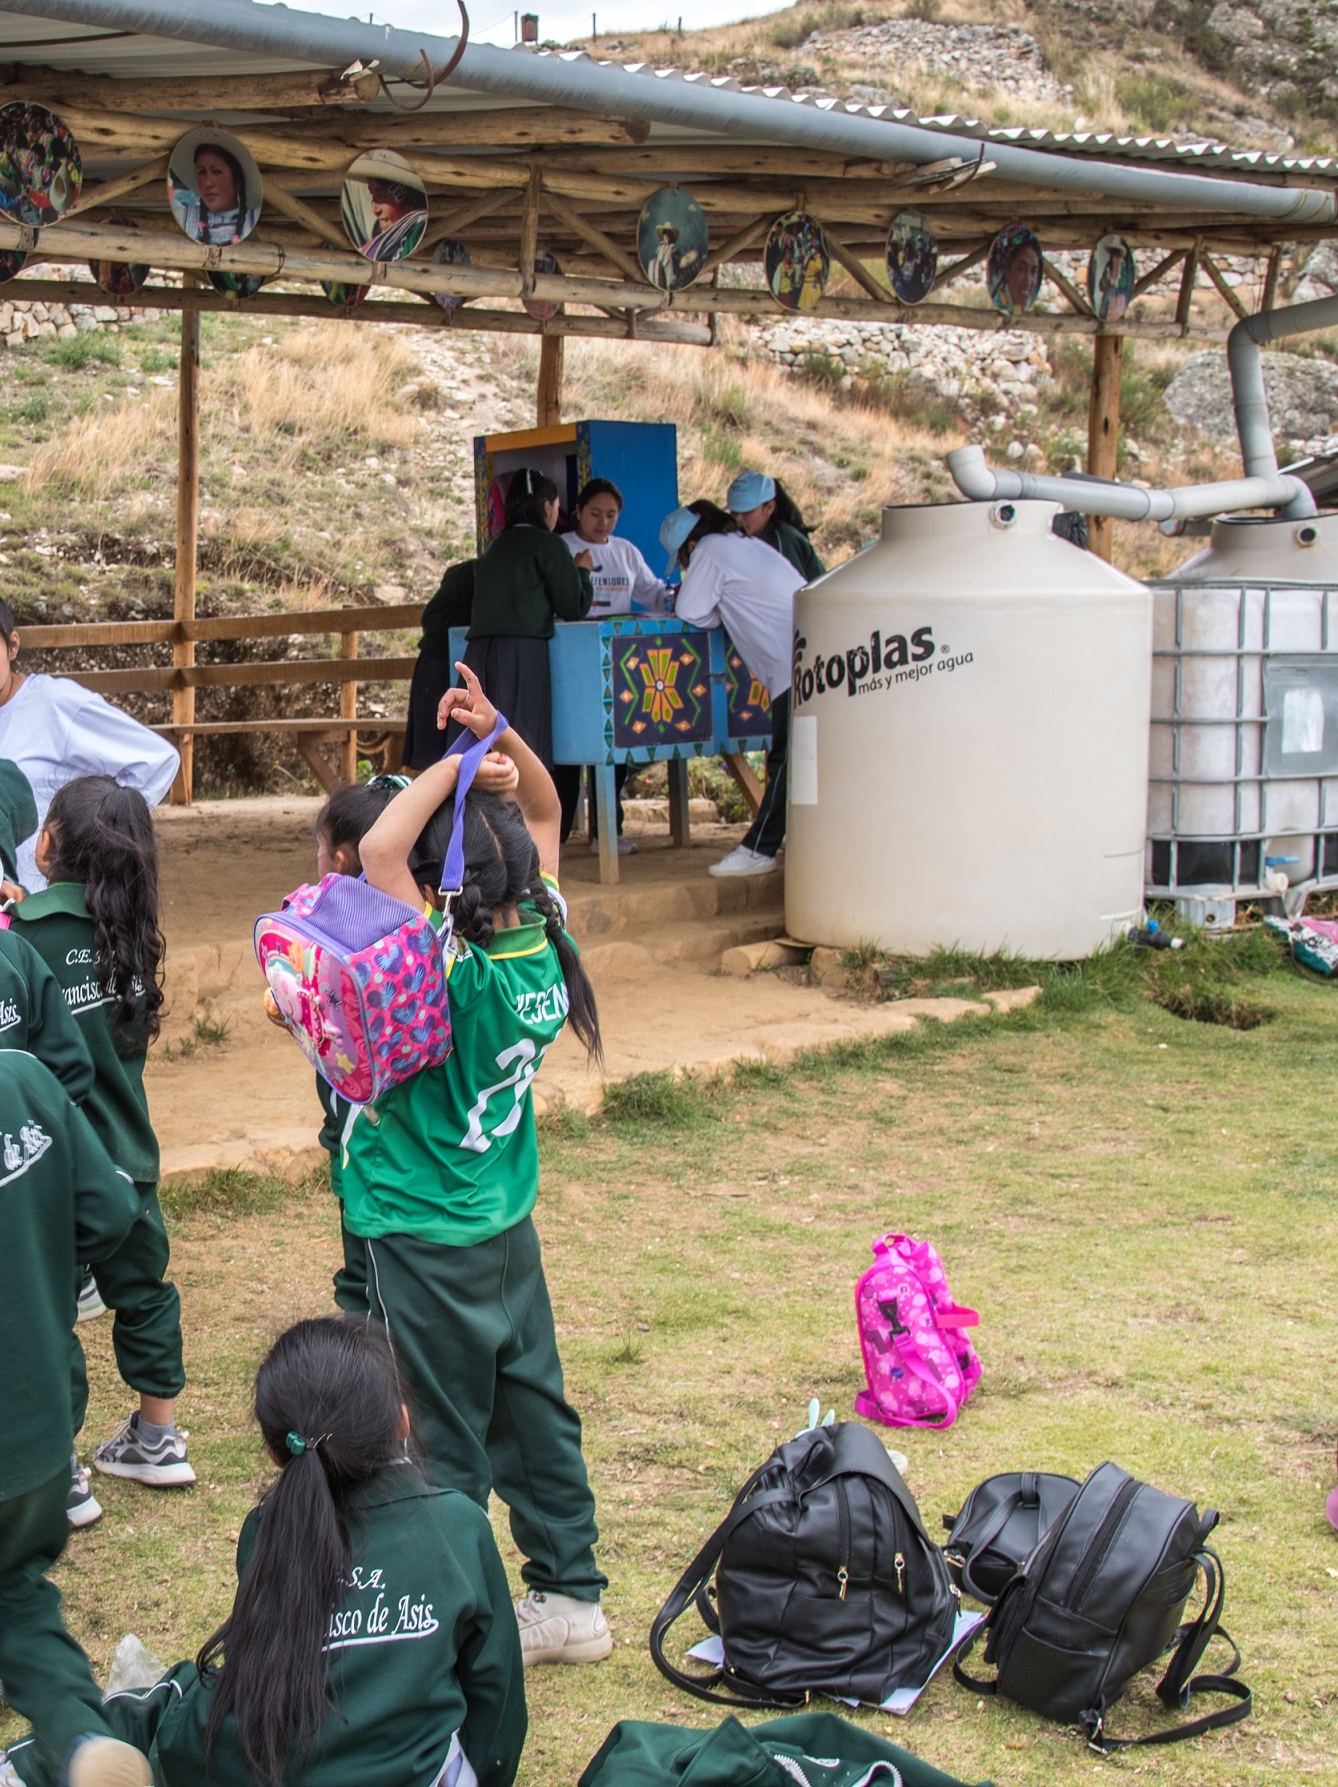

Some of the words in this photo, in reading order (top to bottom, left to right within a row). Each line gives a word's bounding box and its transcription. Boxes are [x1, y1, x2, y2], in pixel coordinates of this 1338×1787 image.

[793, 626, 935, 711] Rotoplas
[858, 678, 883, 695] más
[886, 675, 892, 691] y
[895, 664, 935, 683] mejor
[937, 652, 974, 673] agua
[366, 1592, 389, 1634] de
[391, 1593, 436, 1635] Asis
